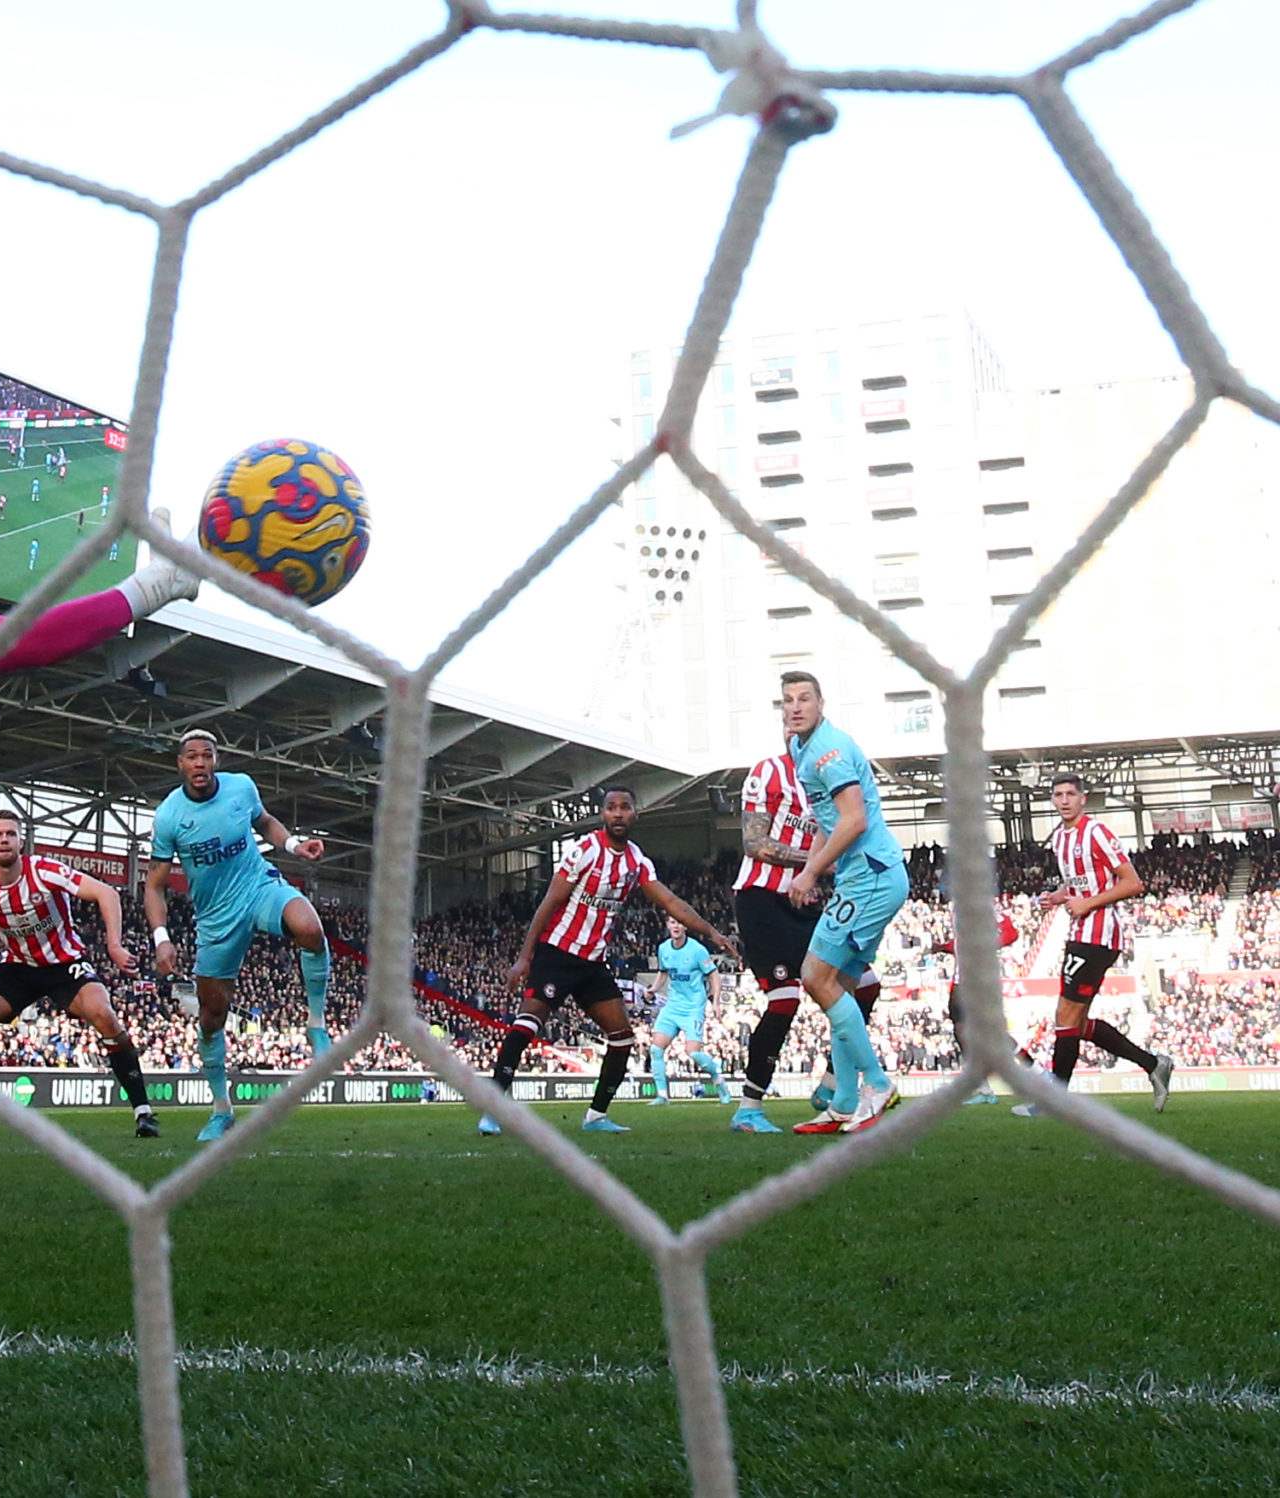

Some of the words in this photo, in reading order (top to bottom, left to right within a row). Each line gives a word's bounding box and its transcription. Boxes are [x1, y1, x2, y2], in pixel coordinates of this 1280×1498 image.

[825, 893, 856, 925] 20
[51, 1079, 115, 1105] UNIBET
[344, 1080, 389, 1102] UNIBET
[511, 1081, 547, 1100] UNIBET
